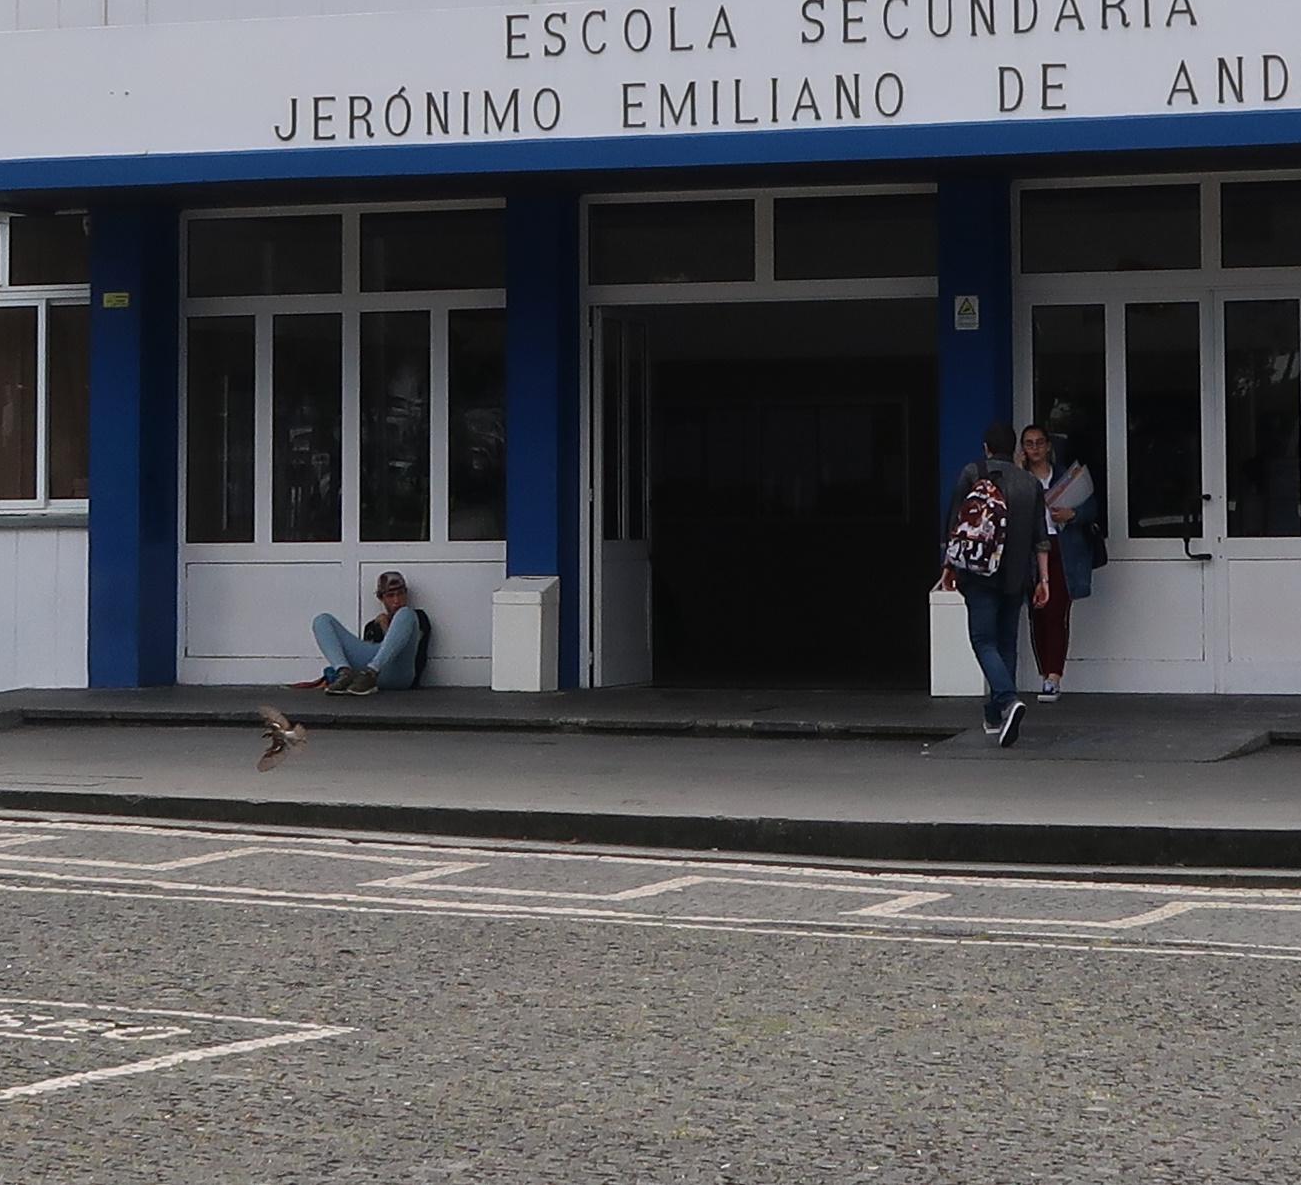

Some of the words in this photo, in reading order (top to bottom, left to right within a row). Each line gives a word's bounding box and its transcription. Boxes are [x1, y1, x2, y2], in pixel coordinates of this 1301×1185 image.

[504, 5, 738, 61] ESCOLA
[273, 86, 562, 143] JERÓNIMO
[621, 72, 905, 129] EMILIANO
[997, 62, 1068, 114] DE
